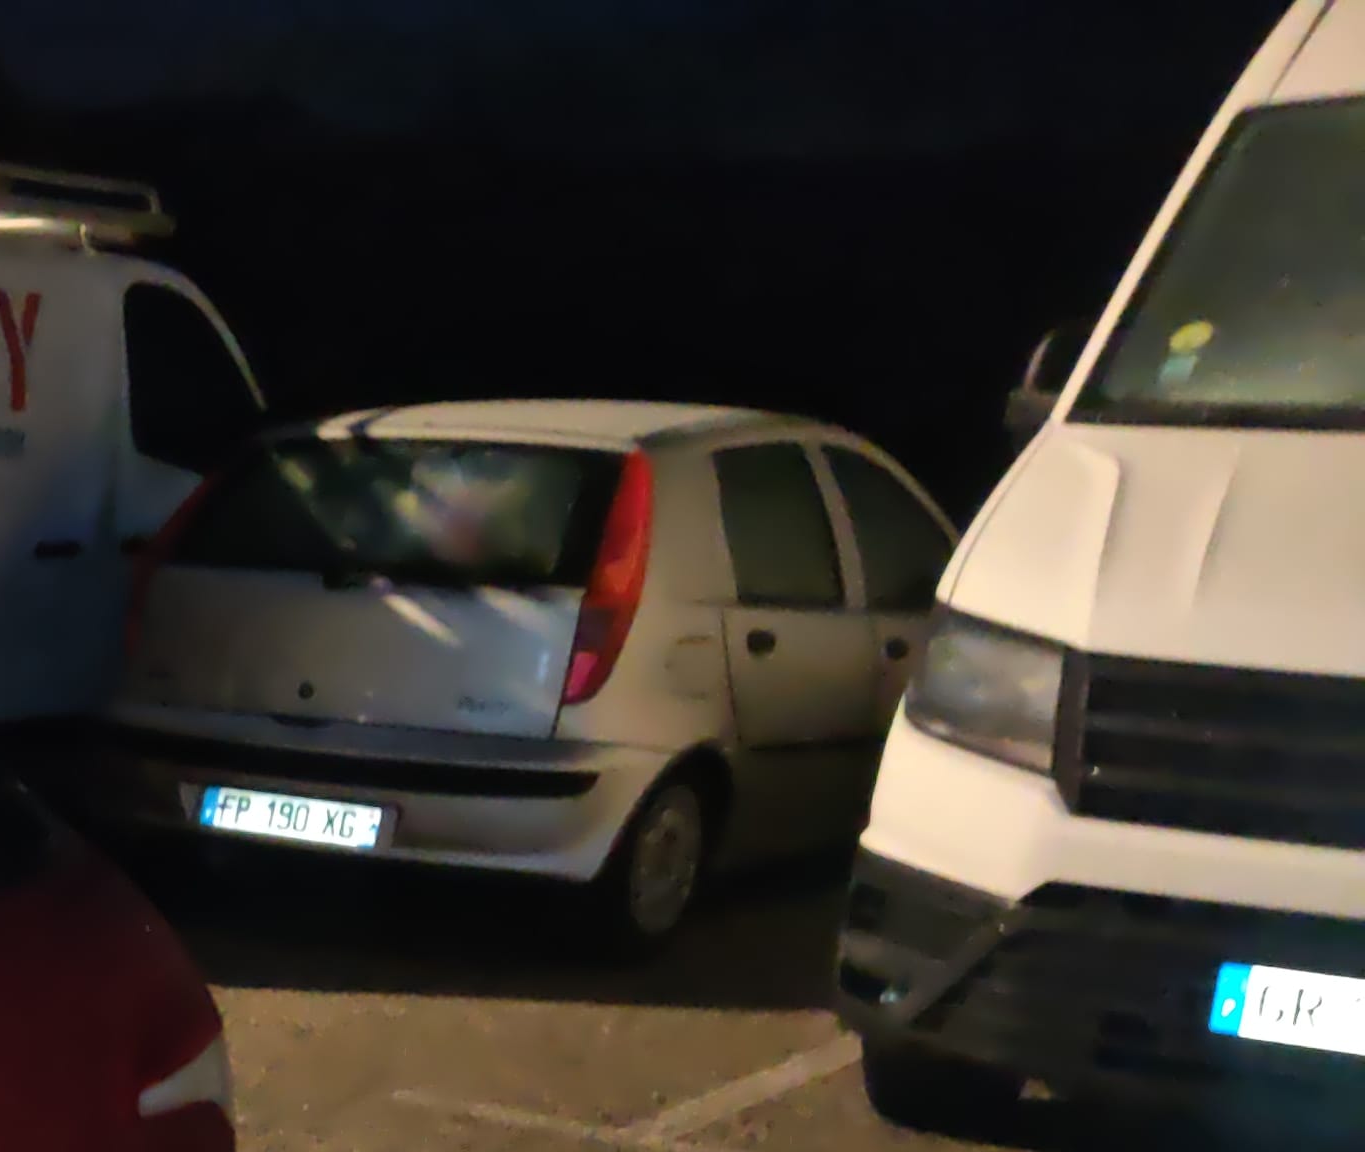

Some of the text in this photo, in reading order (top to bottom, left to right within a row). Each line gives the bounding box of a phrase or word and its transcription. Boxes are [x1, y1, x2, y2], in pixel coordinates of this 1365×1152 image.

[218, 794, 357, 839] FP 190 XG
